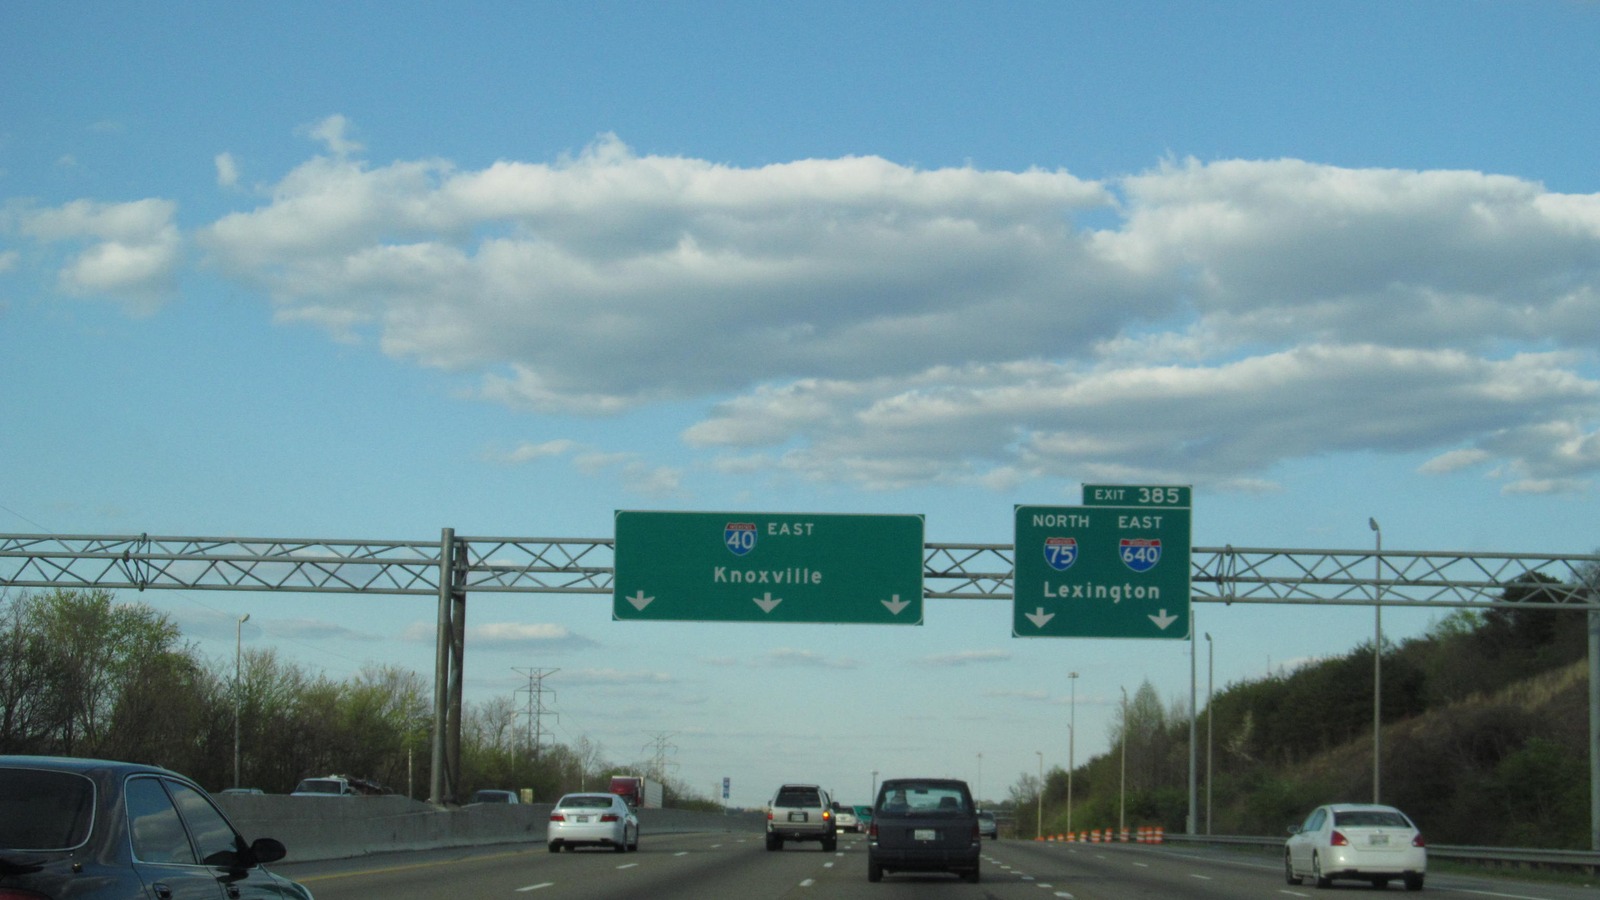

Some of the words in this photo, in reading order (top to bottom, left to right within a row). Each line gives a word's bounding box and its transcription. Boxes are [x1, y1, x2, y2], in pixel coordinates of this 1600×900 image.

[1095, 489, 1126, 501] EXIT
[1138, 487, 1179, 504] 385
[768, 522, 814, 536] EAST
[1033, 514, 1090, 528] NORTH
[1118, 516, 1163, 529] EAST
[726, 531, 755, 550] 40
[1047, 546, 1074, 564] 75
[1123, 547, 1158, 563] 640
[714, 566, 823, 585] Knoxville
[1044, 581, 1160, 604] Lexington
